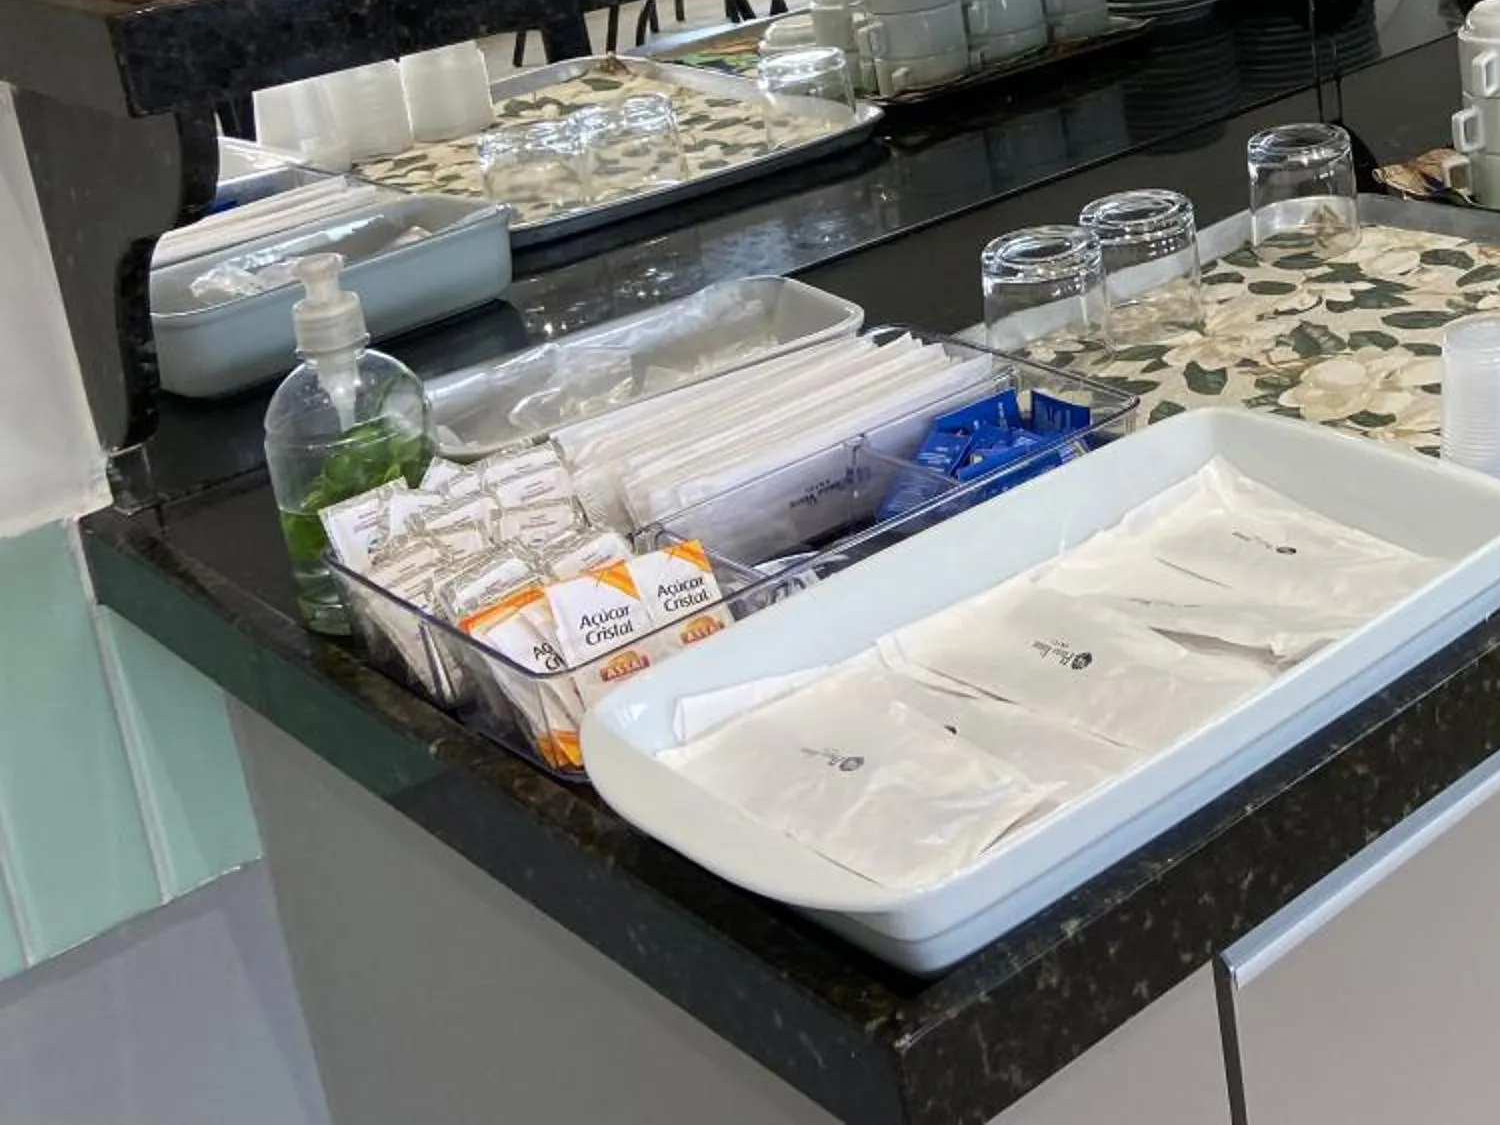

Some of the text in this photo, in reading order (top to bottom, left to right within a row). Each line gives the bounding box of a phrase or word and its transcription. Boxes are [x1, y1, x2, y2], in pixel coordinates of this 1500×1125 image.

[663, 588, 711, 612] Cristal
[579, 603, 631, 630] Açúcar
[585, 619, 634, 646] Cristal
